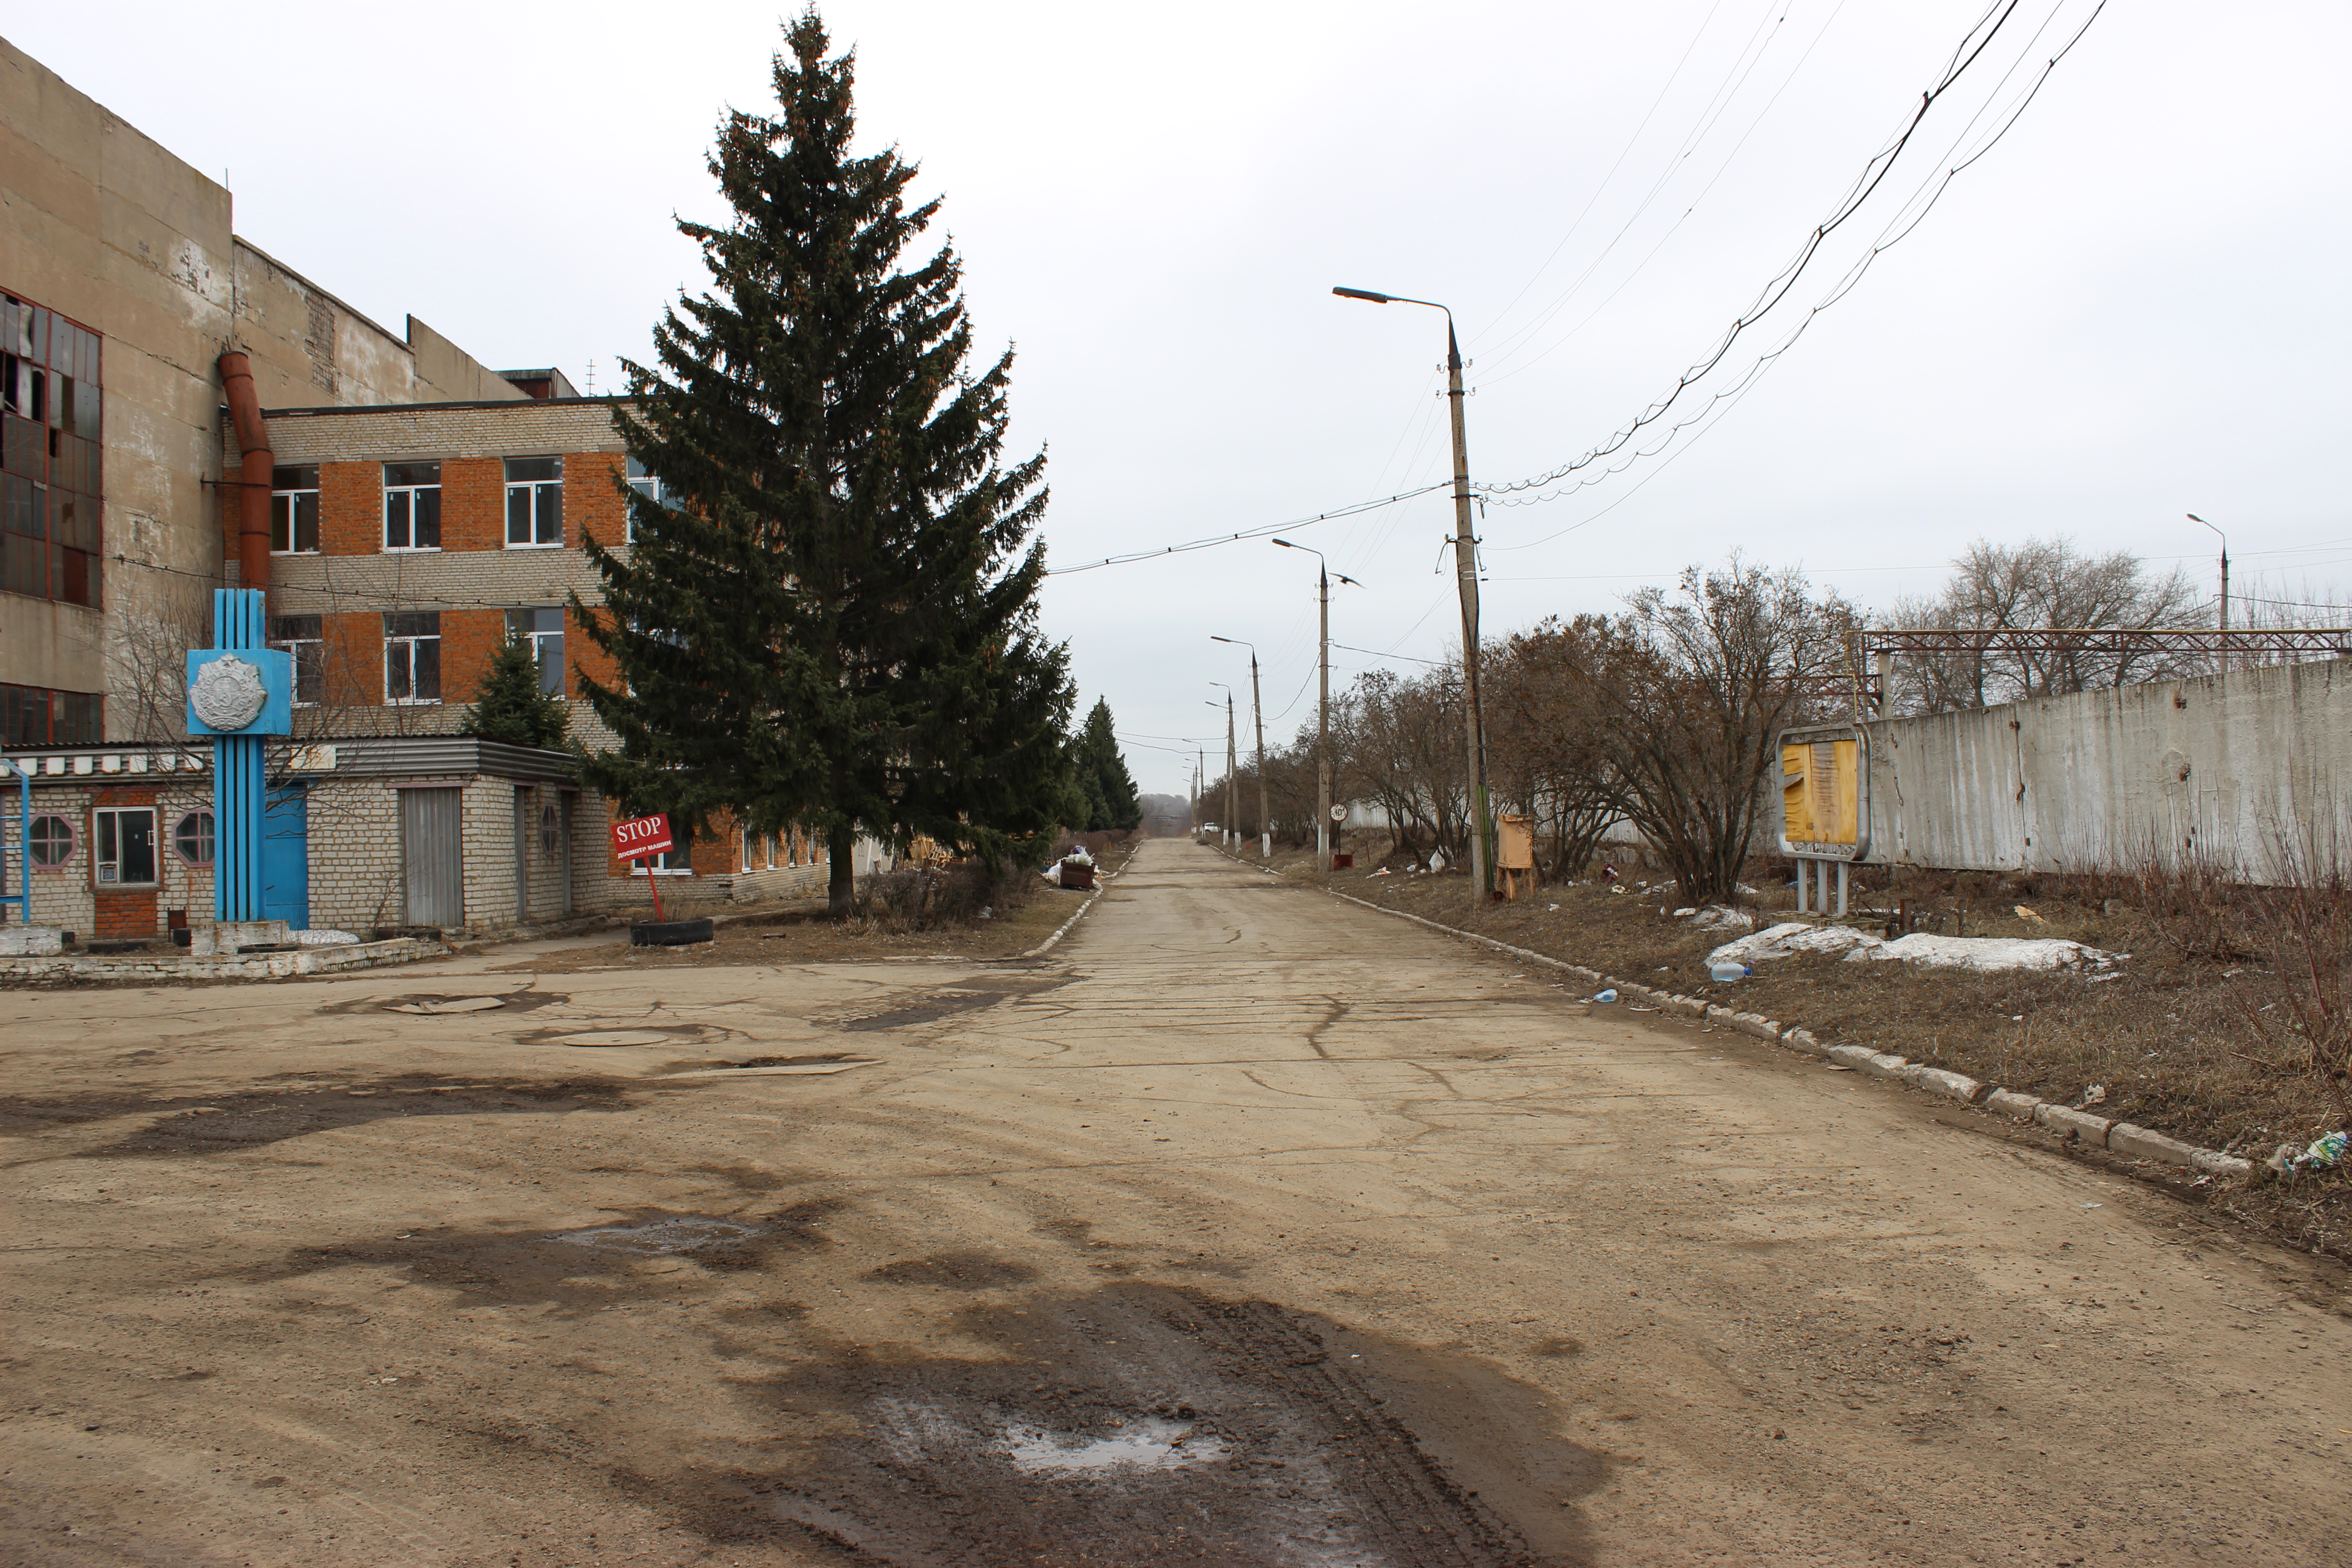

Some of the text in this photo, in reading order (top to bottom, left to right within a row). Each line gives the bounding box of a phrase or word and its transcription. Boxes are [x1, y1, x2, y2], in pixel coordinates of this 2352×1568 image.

[617, 817, 661, 843] STOP
[617, 840, 671, 859] ДОСМОТР МАШИН
